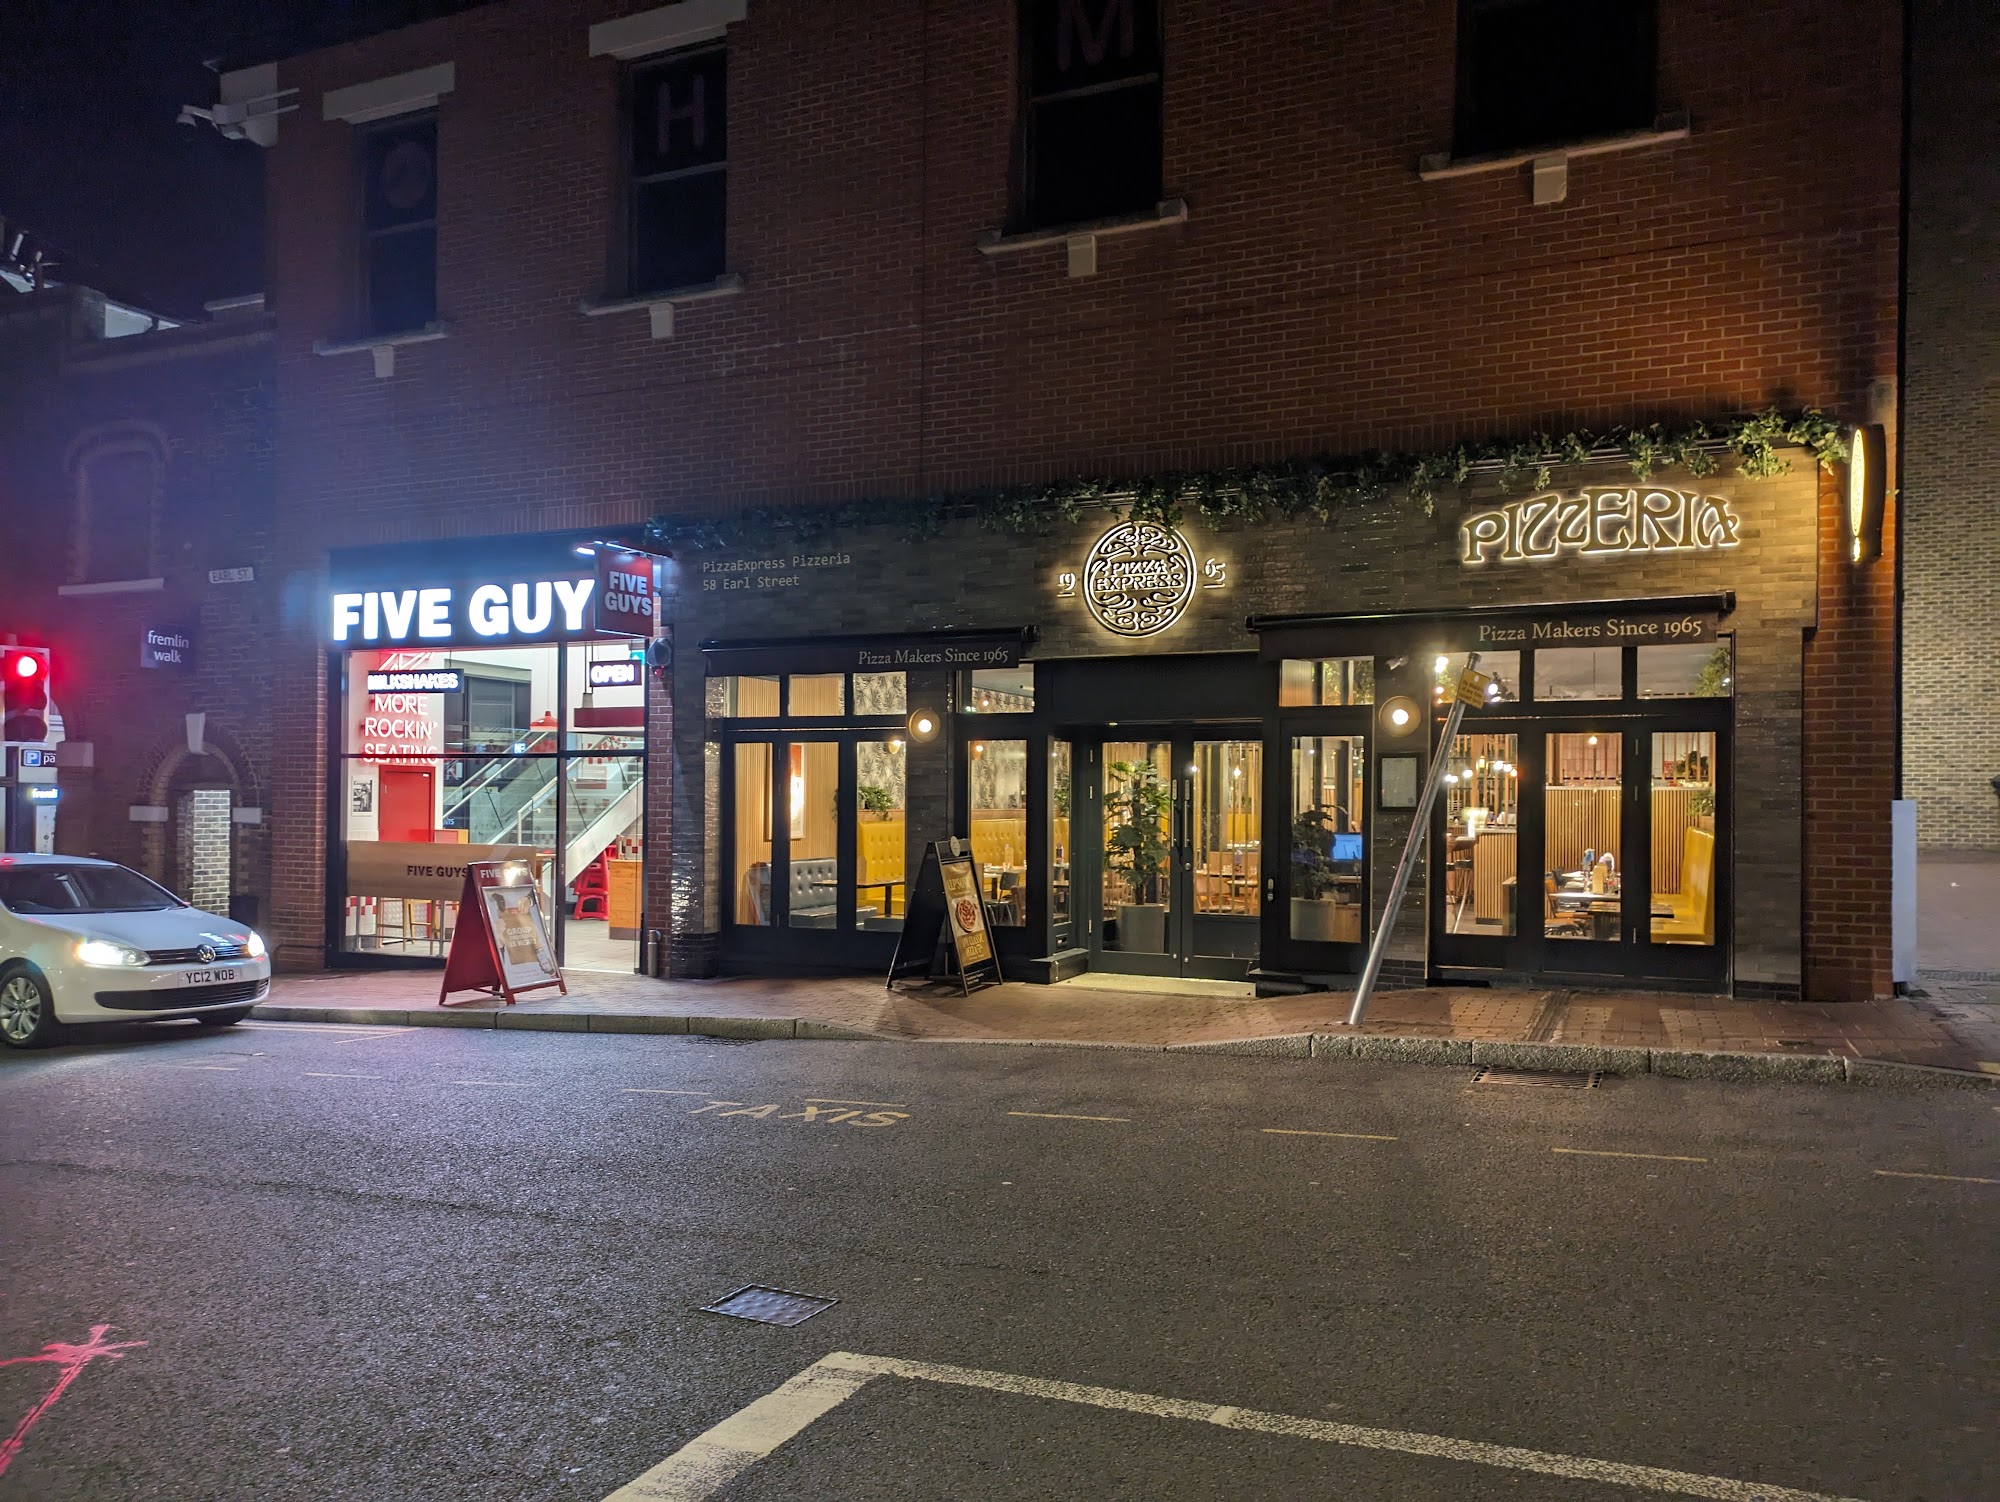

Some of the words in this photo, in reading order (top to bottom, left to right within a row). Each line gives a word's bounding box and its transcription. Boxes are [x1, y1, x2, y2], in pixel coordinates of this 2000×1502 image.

[657, 74, 704, 155] H
[1463, 487, 1740, 563] PIZZERIA
[703, 559, 785, 573] PizzaExpress
[792, 553, 850, 567] Pizzeria
[609, 571, 648, 595] FIVE
[703, 580, 717, 591] 58
[723, 577, 750, 590] Earl
[757, 575, 800, 588] Street
[1095, 573, 1184, 591] EXPRESS
[604, 591, 652, 616] GUYS
[333, 588, 451, 641] FIVE
[1479, 625, 1526, 642] Pizza
[1532, 621, 1600, 639] Makers
[1607, 618, 1659, 636] Since
[1664, 616, 1702, 638] 1965
[148, 630, 189, 649] fremlin
[154, 649, 181, 663] walk
[858, 650, 891, 665] Pizza
[894, 649, 942, 664] Makers
[945, 647, 980, 662] Since
[983, 647, 1009, 664] 1965
[367, 672, 459, 691] MILKSHAKES
[590, 663, 635, 684] OPEN
[375, 693, 428, 716] MORE
[364, 716, 438, 740] ROCKIN'
[363, 742, 439, 764] SEATING
[407, 865, 433, 877] FIVE
[436, 866, 468, 879] GUYS
[480, 869, 502, 879] FIVE
[506, 926, 532, 936] GROUP
[186, 971, 211, 984] YC12
[213, 969, 235, 982] WOB
[688, 1101, 911, 1127] TAXIS
